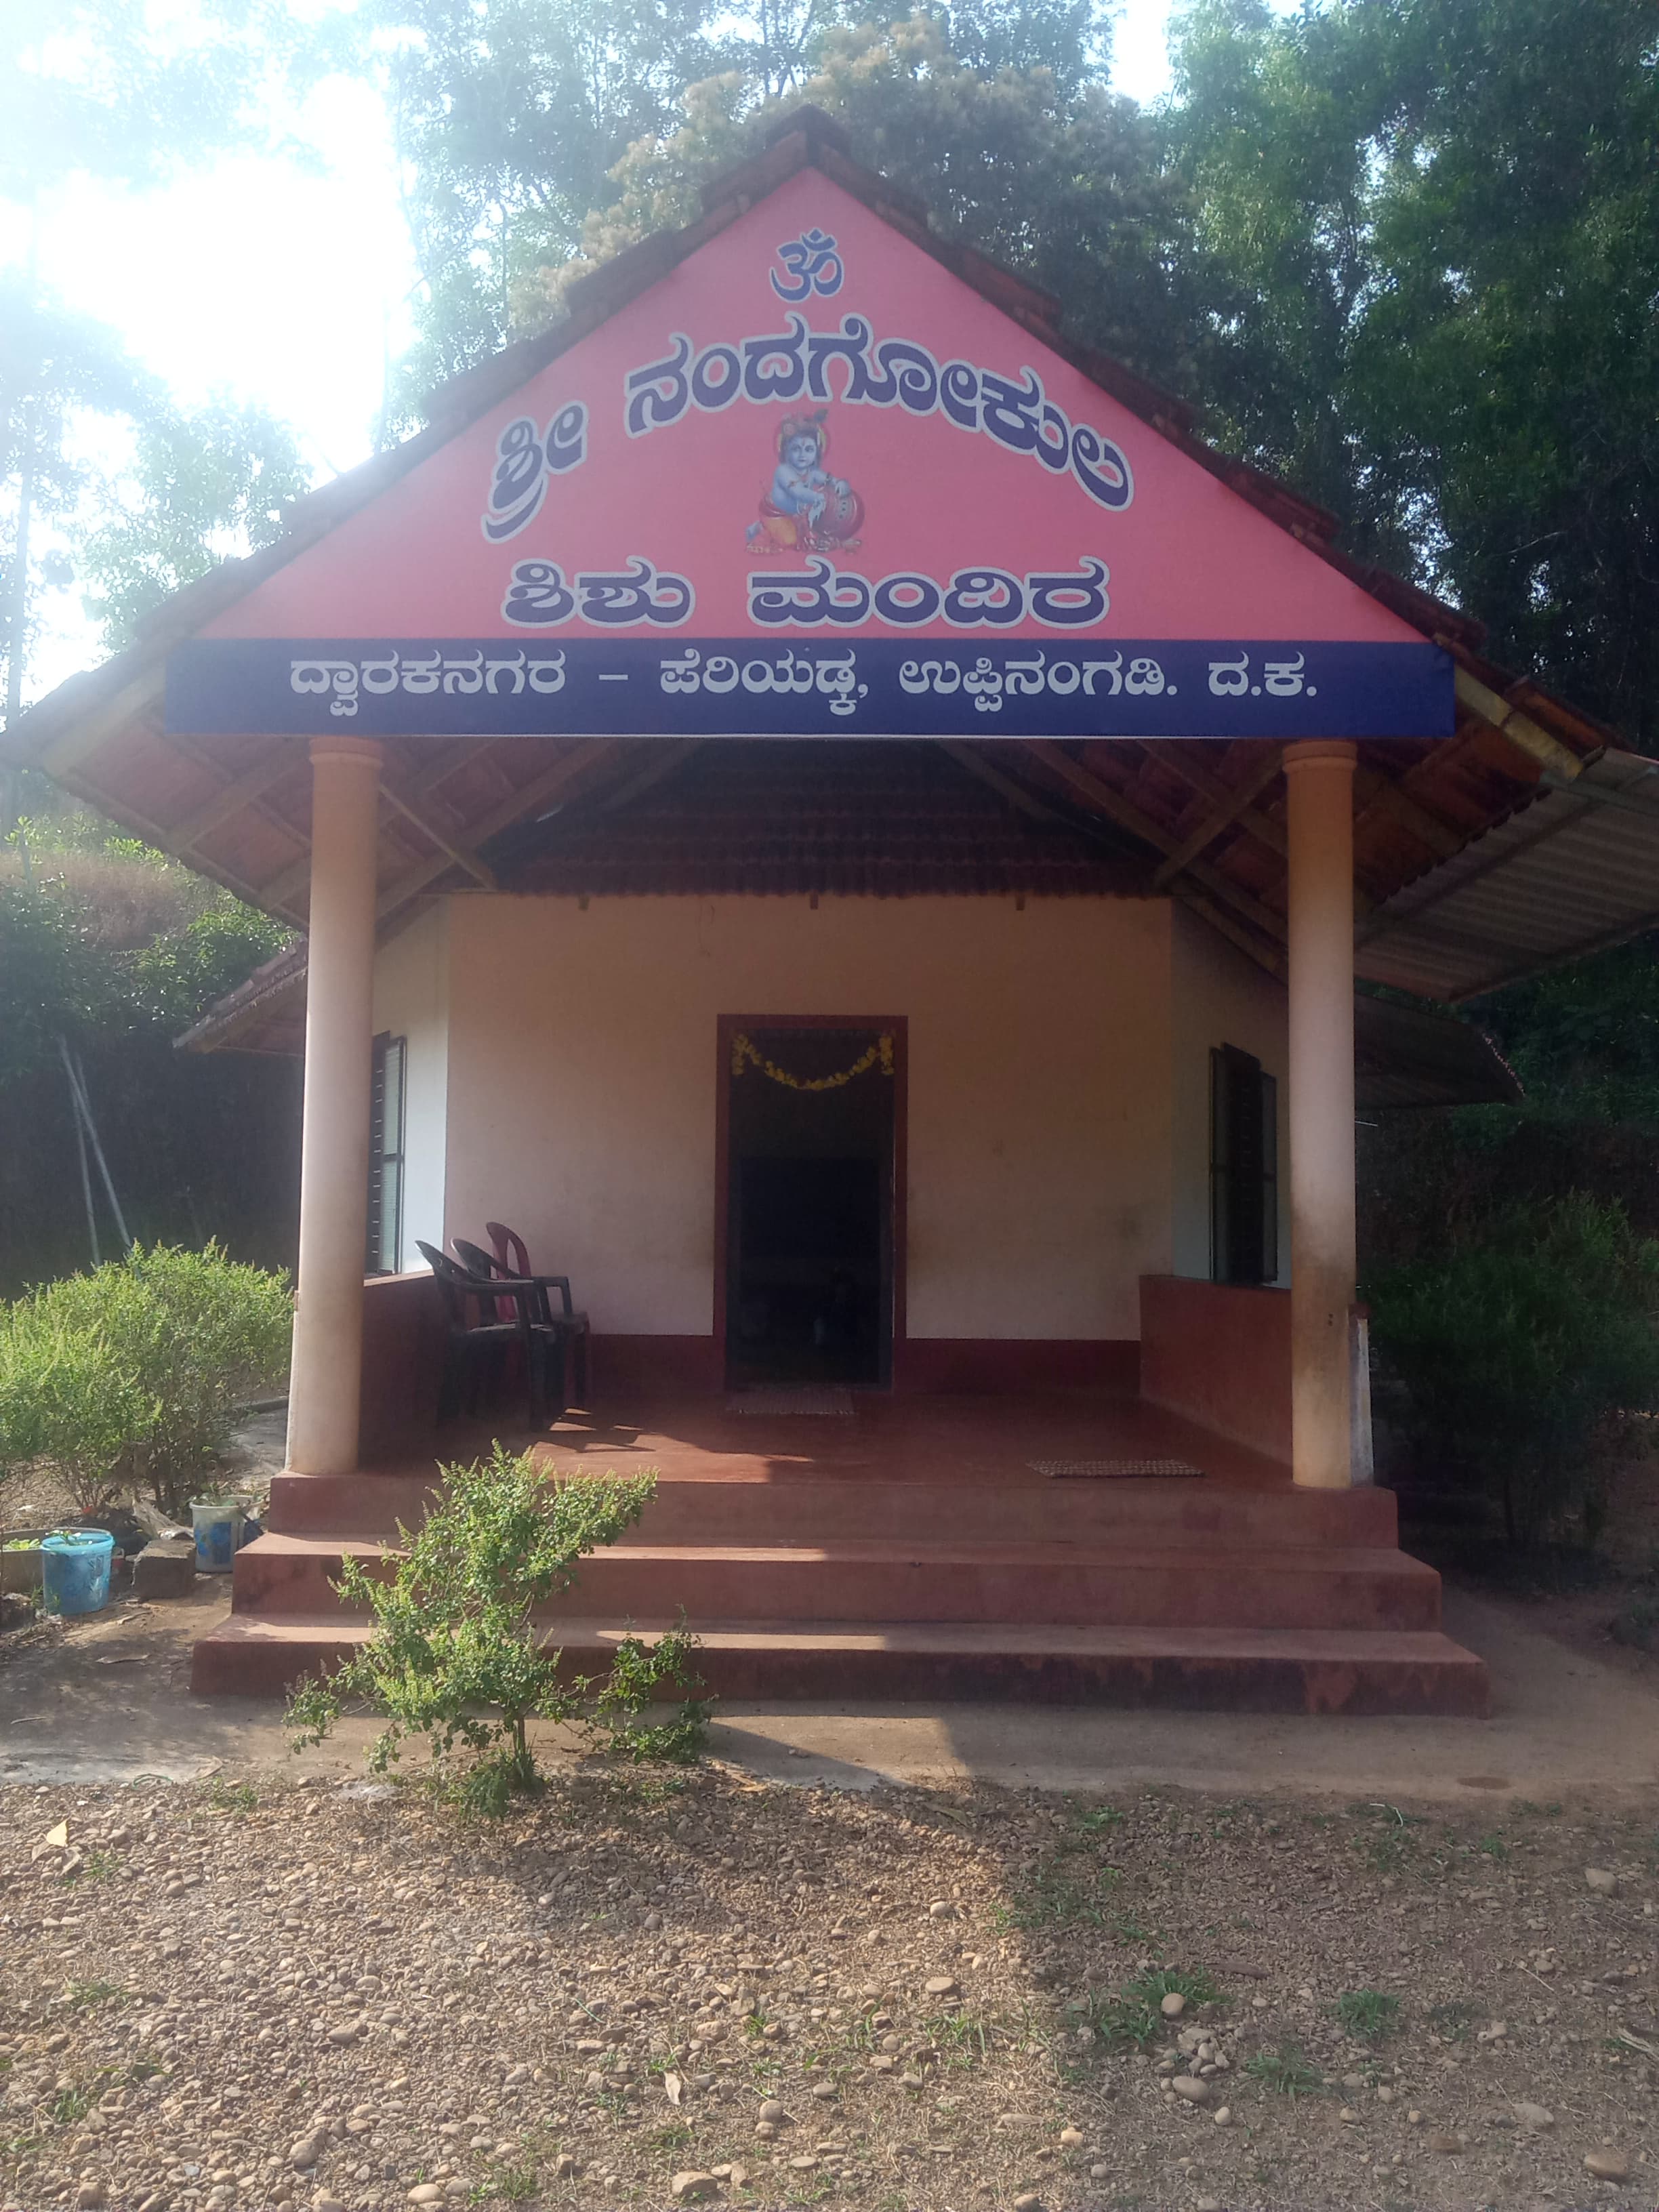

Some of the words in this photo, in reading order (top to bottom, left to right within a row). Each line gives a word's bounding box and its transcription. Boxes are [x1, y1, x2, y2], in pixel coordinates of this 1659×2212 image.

[481, 401, 588, 543] ಶ್ರೀ
[624, 312, 1134, 511] ನಂದಗೋಕುಲ
[501, 556, 695, 628] ಶಿಶು
[747, 556, 1111, 629] ಮಂದಿರ
[290, 649, 566, 716] ದ್ವಾರಕನಗರ
[660, 648, 869, 716] ಪೆರಿಯಡ್ಕ,
[899, 649, 1178, 712] ಉಪ್ಪಿನಂಗಡಿ.
[1208, 651, 1317, 697] ದ.ಕ.
